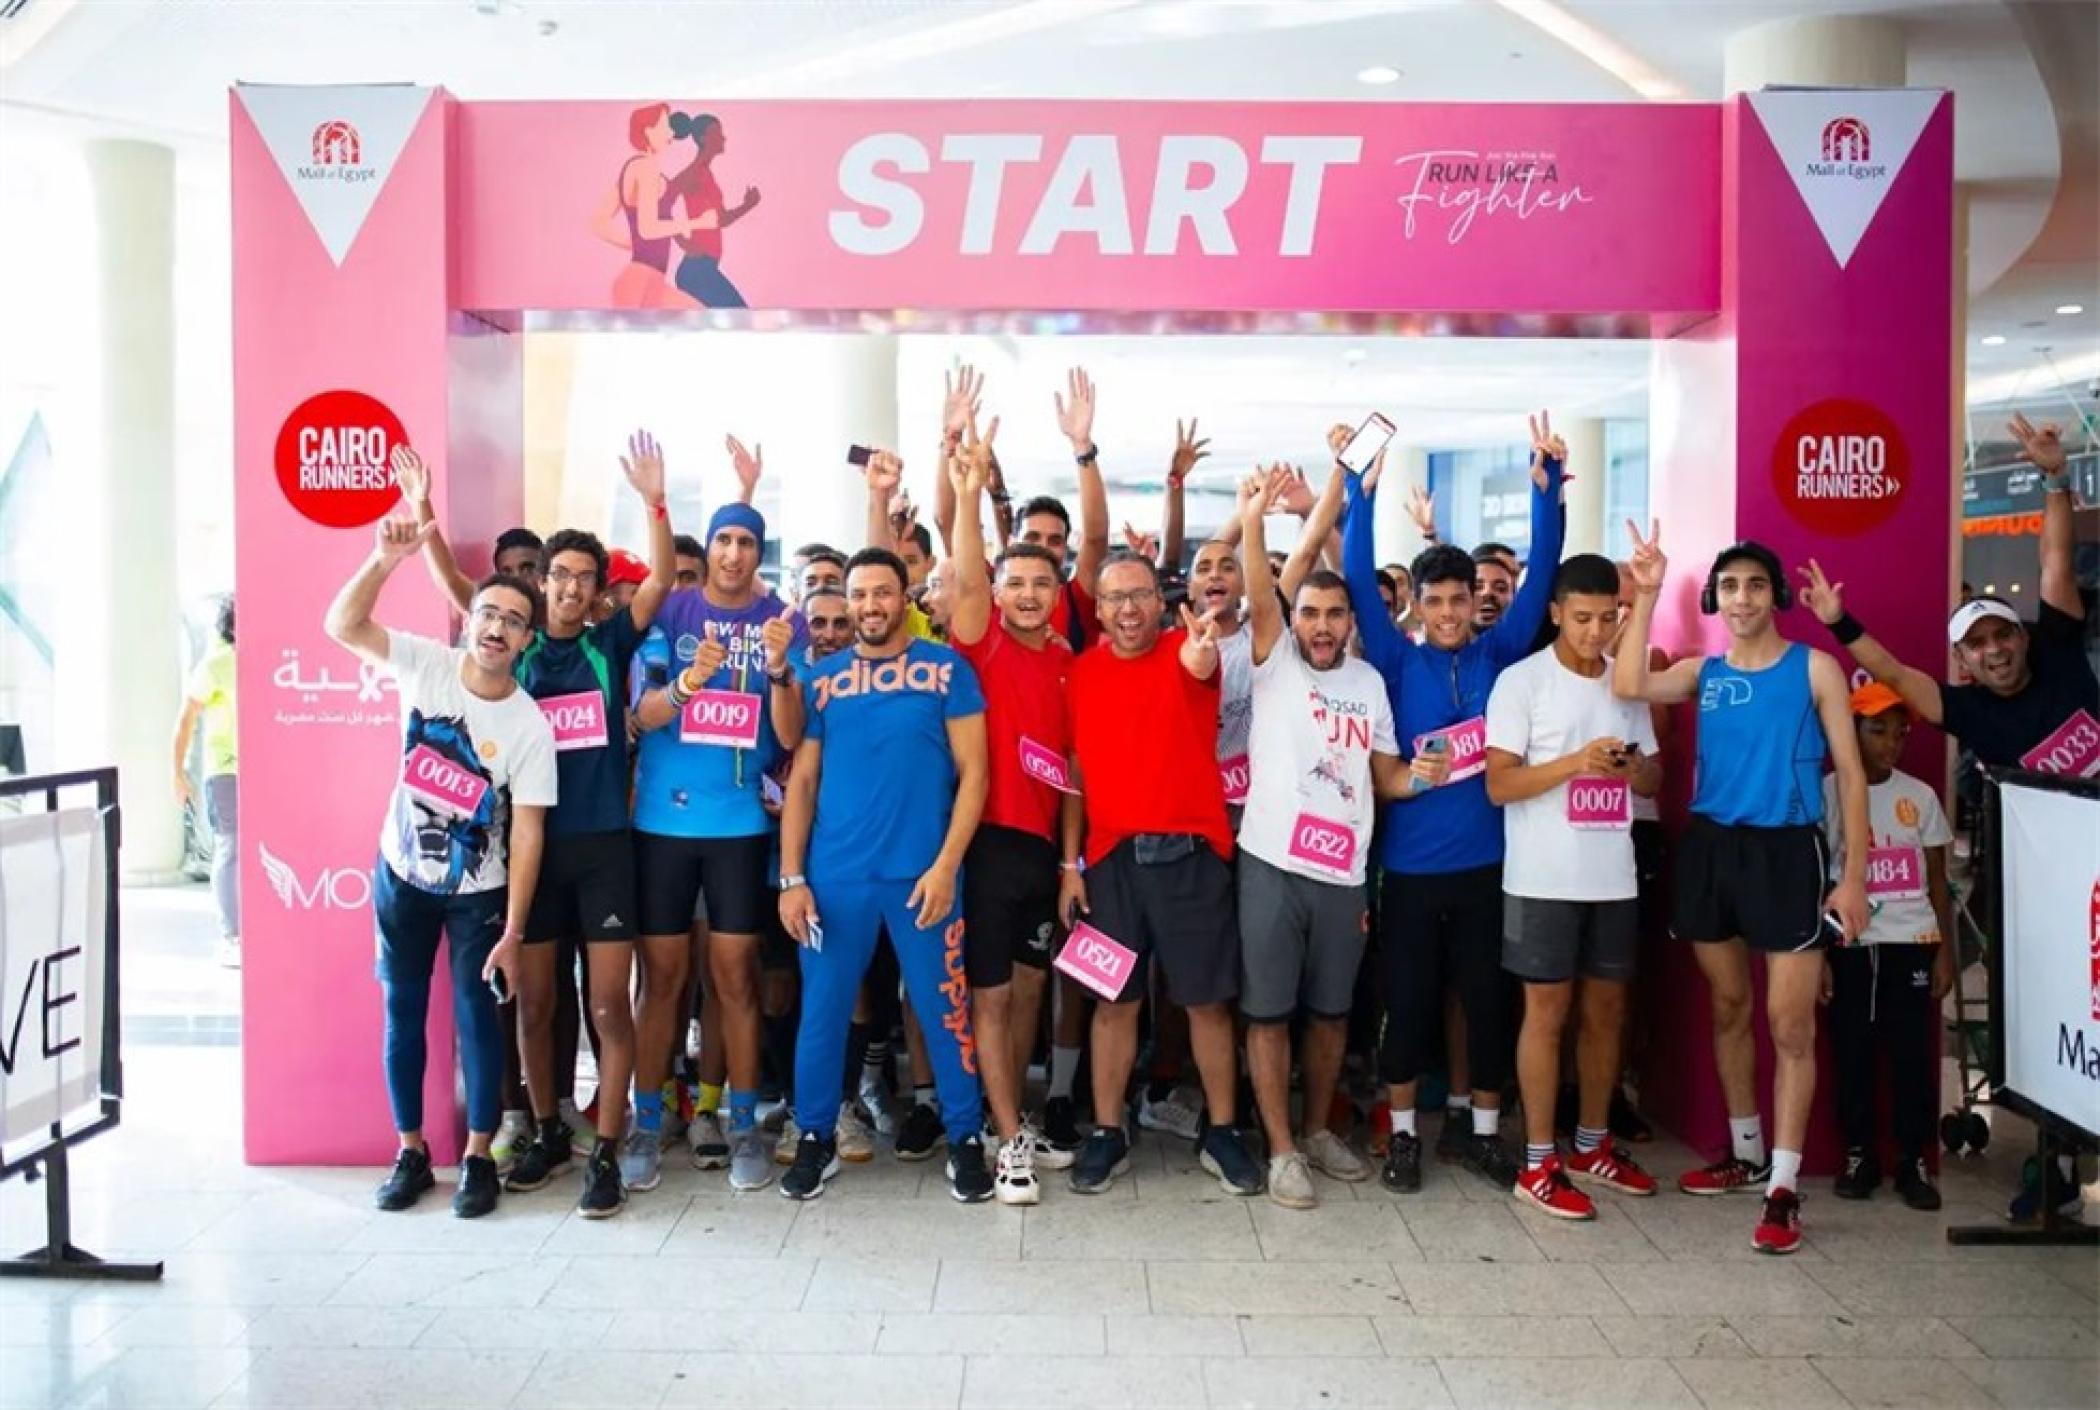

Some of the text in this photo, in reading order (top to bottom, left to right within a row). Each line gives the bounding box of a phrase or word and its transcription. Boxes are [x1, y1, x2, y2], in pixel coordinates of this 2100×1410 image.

[297, 167, 325, 178] Mall
[338, 167, 375, 182] Egypt
[1428, 163, 1559, 183] RUN LIKE A
[1806, 164, 1834, 175] Mall
[1848, 164, 1886, 179] Egypt
[828, 133, 1363, 257] START
[1394, 150, 1593, 244] Fighter
[300, 426, 387, 466] CAIRO
[1798, 435, 1886, 474] CAIRO
[300, 466, 385, 490] RUNNERS
[1798, 475, 1884, 499] RUNNERS
[693, 701, 749, 727] 0019
[417, 757, 476, 798] 0013
[1572, 788, 1624, 811] 0007
[1300, 824, 1348, 860] 0522
[1866, 859, 1909, 884] 184
[1076, 936, 1122, 977] 0521
[2057, 1022, 2100, 1081] Ma
